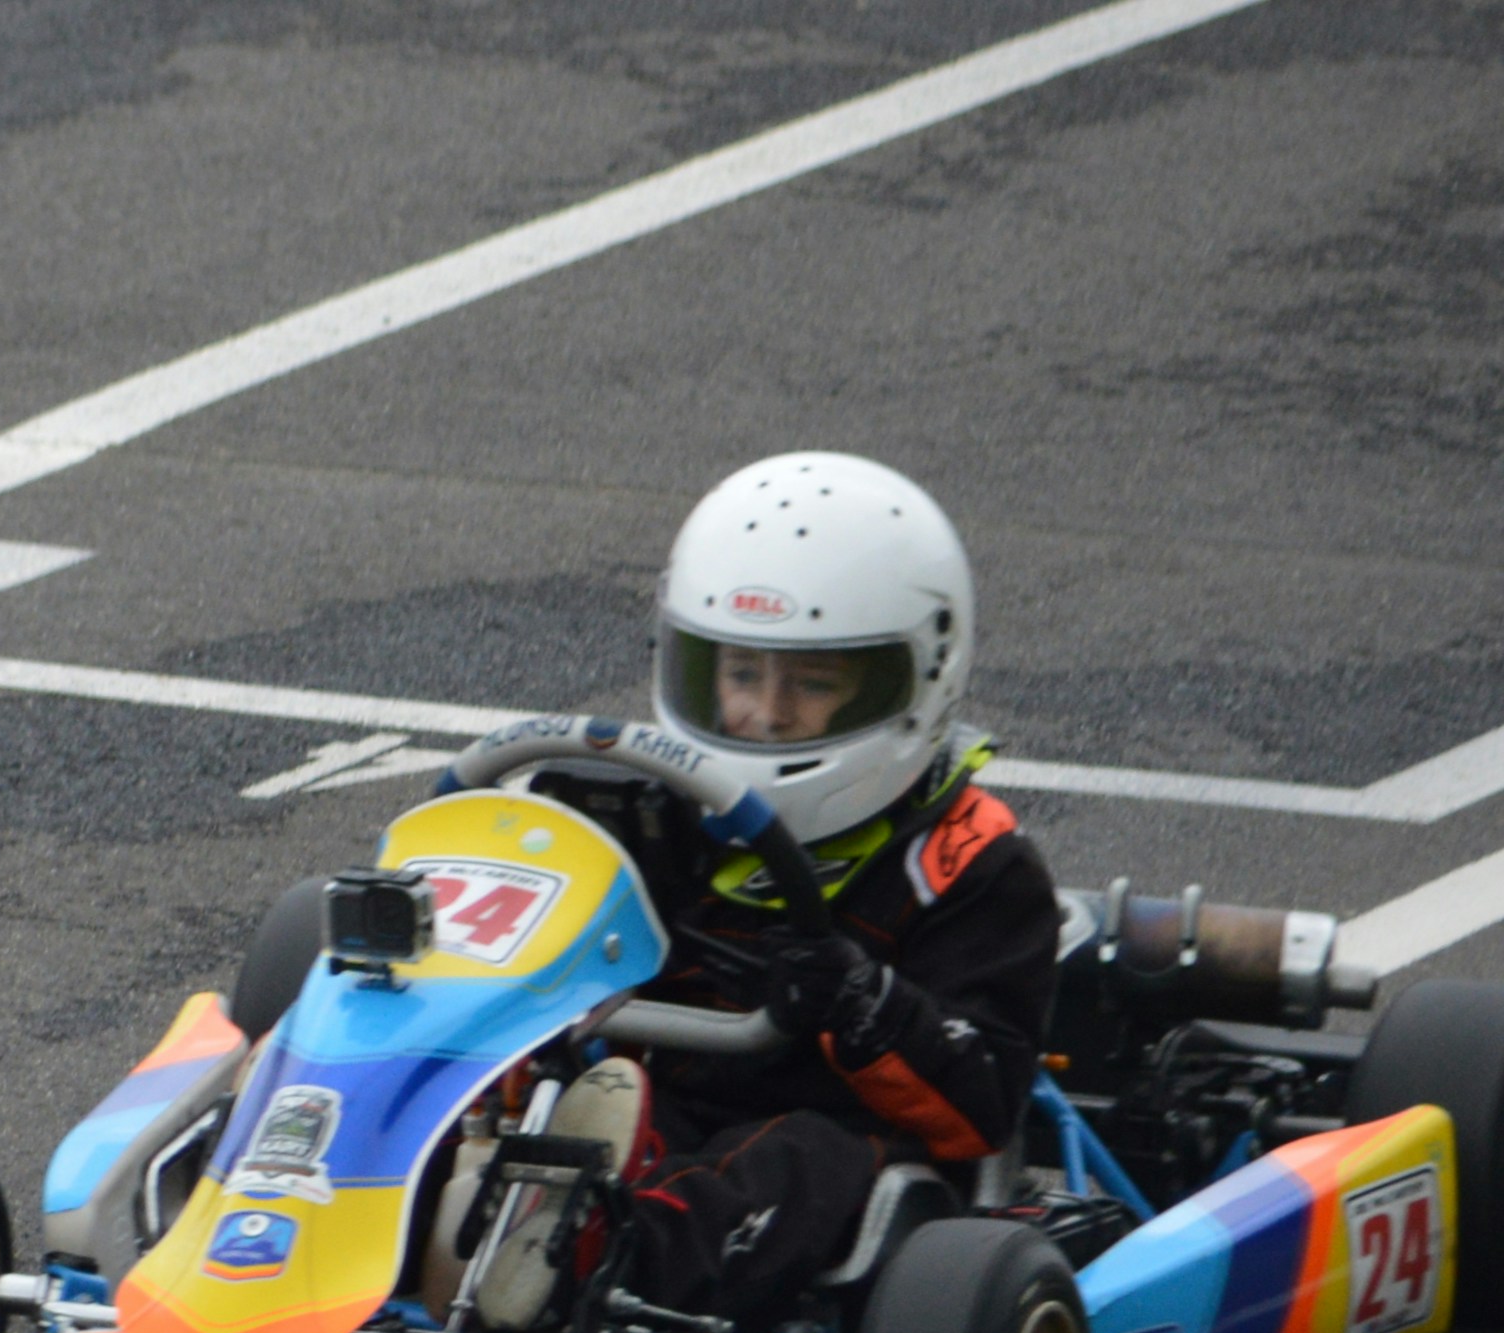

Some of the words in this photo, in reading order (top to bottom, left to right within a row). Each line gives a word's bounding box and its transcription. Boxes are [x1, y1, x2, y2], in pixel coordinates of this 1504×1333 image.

[731, 593, 787, 616] BELL
[629, 727, 711, 774] KART
[1354, 1197, 1432, 1326] 24
